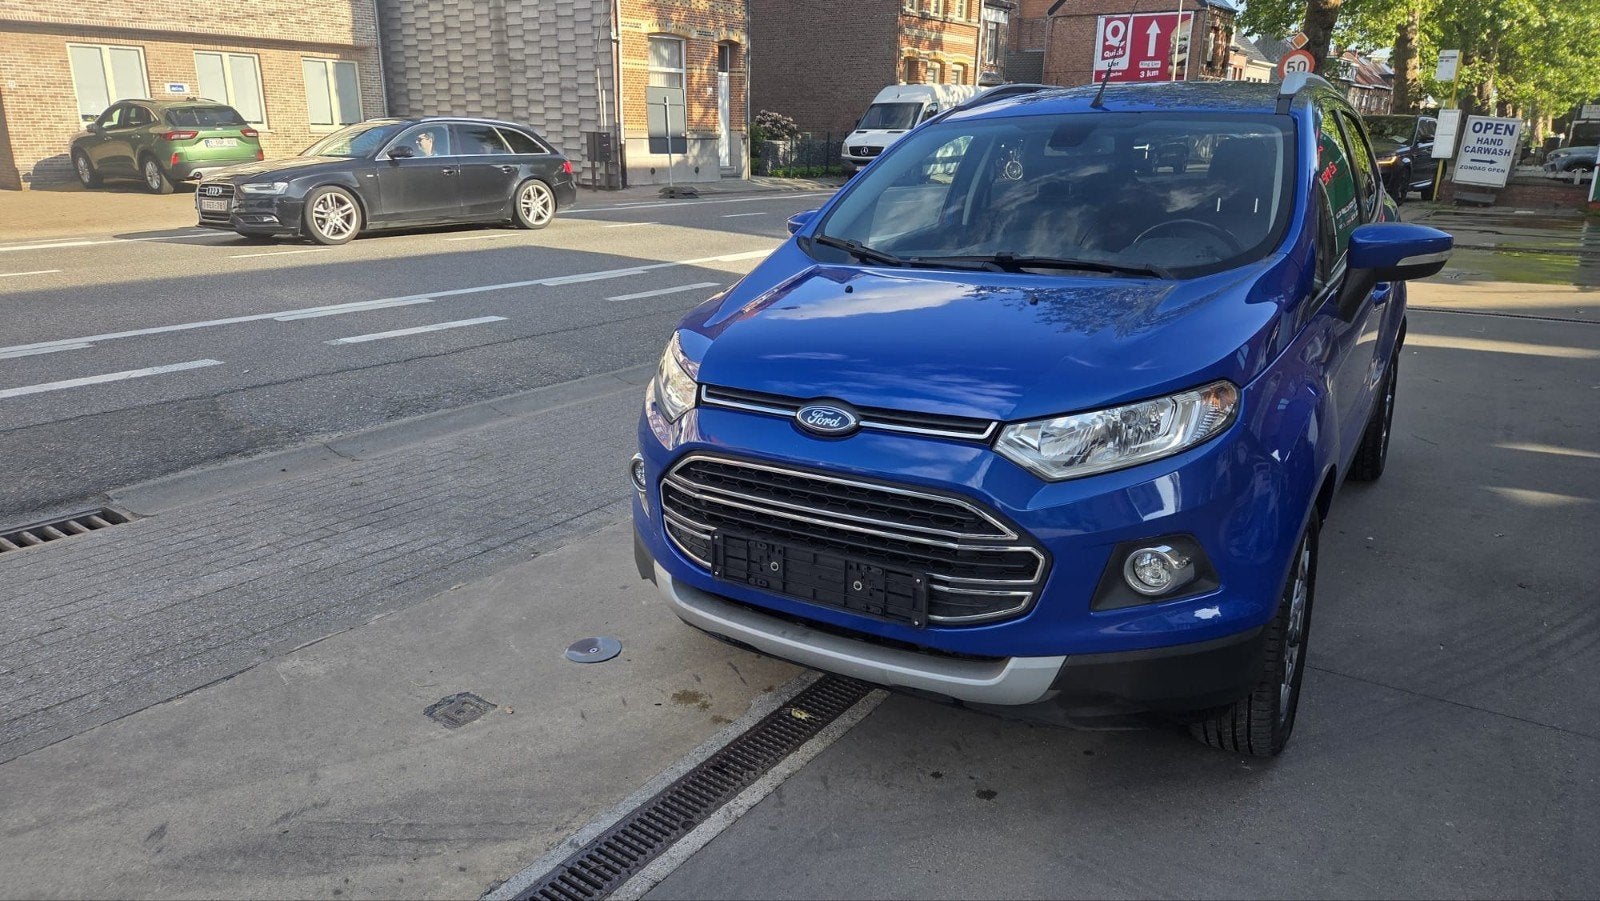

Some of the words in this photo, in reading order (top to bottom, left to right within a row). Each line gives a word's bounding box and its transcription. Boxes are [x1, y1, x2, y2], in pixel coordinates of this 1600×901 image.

[1104, 48, 1124, 58] Quik
[1286, 60, 1307, 73] 50
[1139, 70, 1145, 78] 3
[1146, 70, 1158, 78] km
[1472, 122, 1516, 136] OPEN
[1476, 138, 1504, 146] HAND
[1464, 146, 1512, 156] CARWASH
[807, 409, 842, 427] Ford
